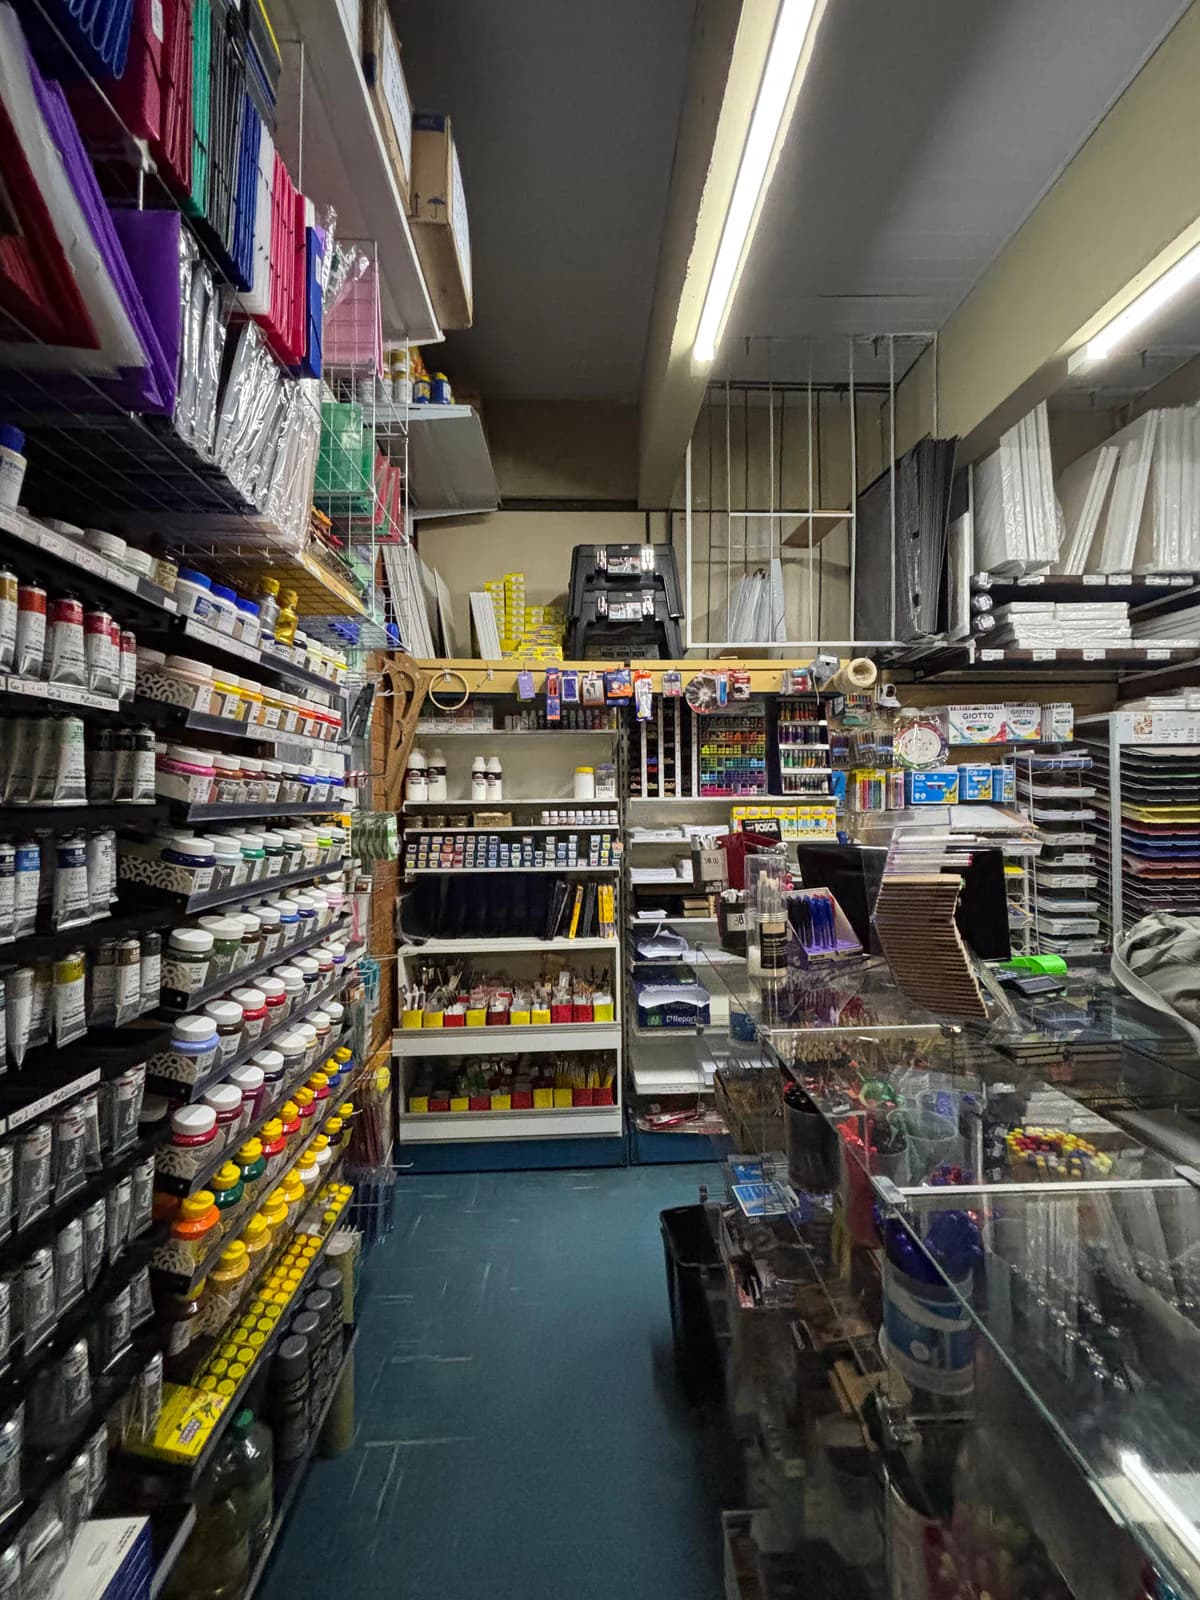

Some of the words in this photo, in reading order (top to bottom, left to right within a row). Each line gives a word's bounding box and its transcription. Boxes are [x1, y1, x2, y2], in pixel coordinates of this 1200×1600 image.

[962, 712, 994, 720] GIOTTO
[1010, 708, 1034, 716] GIOTTO
[754, 822, 778, 833] POSCA
